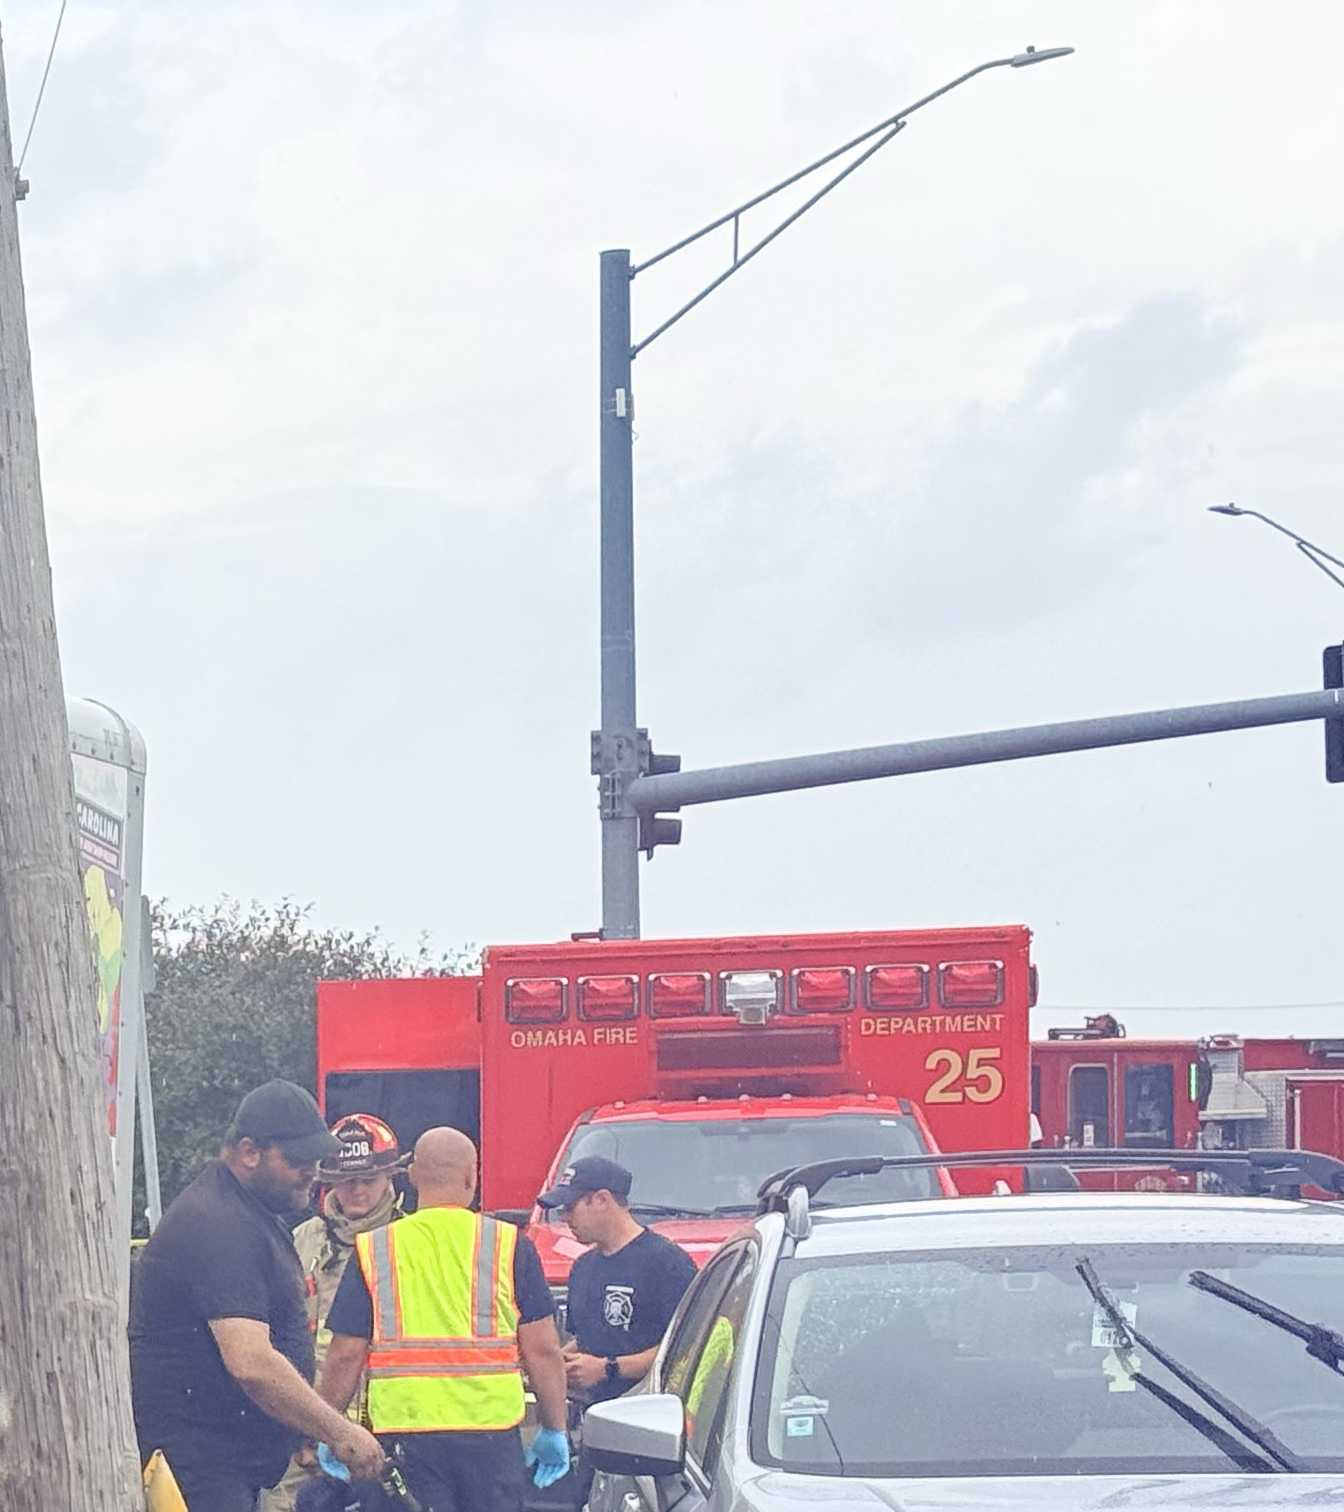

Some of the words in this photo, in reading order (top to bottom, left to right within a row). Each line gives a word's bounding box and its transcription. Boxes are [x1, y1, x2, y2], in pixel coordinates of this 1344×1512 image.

[861, 1014, 1005, 1035] DEPARTMENT
[511, 1029, 587, 1048] OMAHA
[593, 1026, 639, 1045] FIRE
[924, 1047, 1006, 1103] 25
